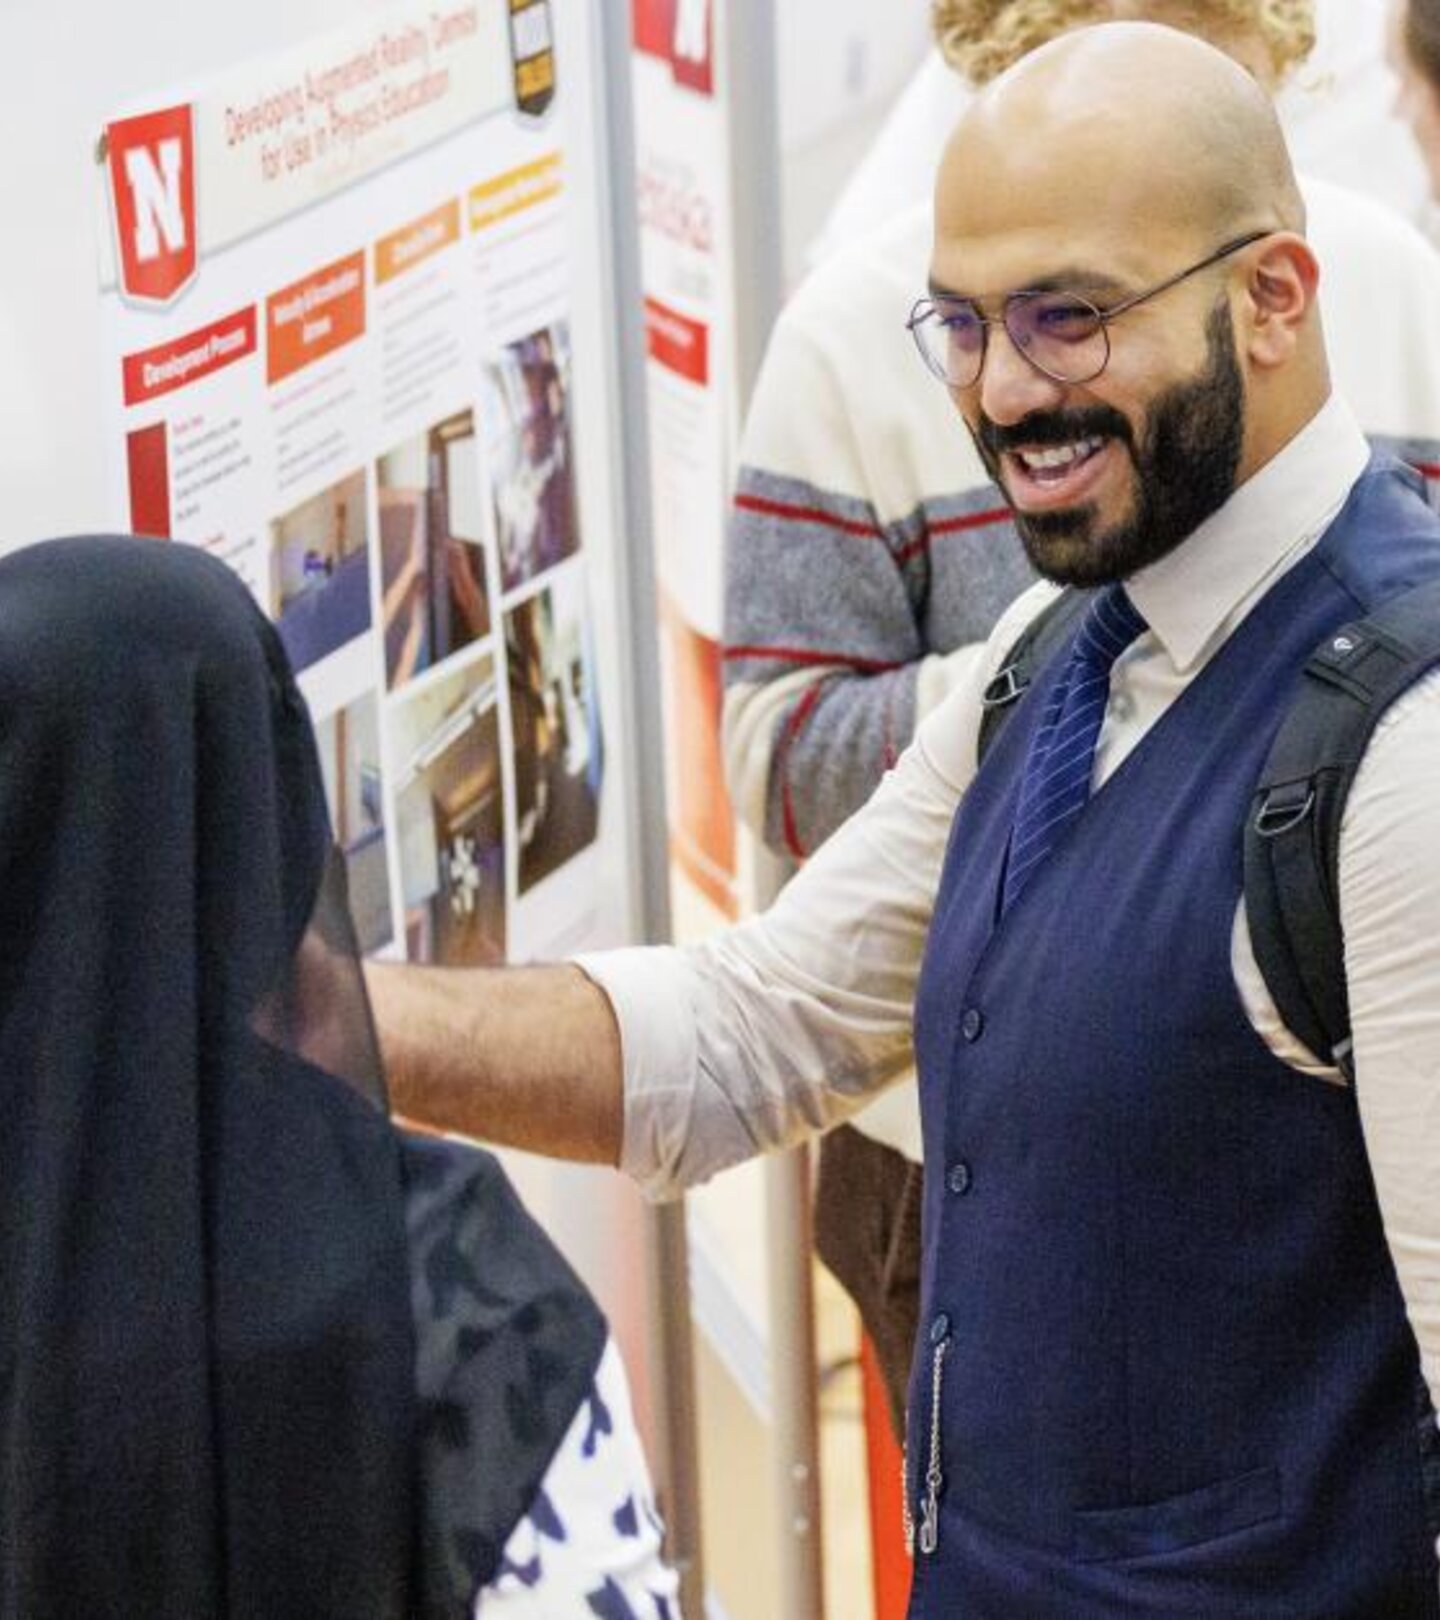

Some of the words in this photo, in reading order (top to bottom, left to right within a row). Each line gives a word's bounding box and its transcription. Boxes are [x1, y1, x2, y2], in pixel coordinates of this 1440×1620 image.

[226, 86, 304, 145] Developing
[261, 143, 281, 181] for
[286, 135, 312, 171] Use
[124, 138, 187, 263] N
